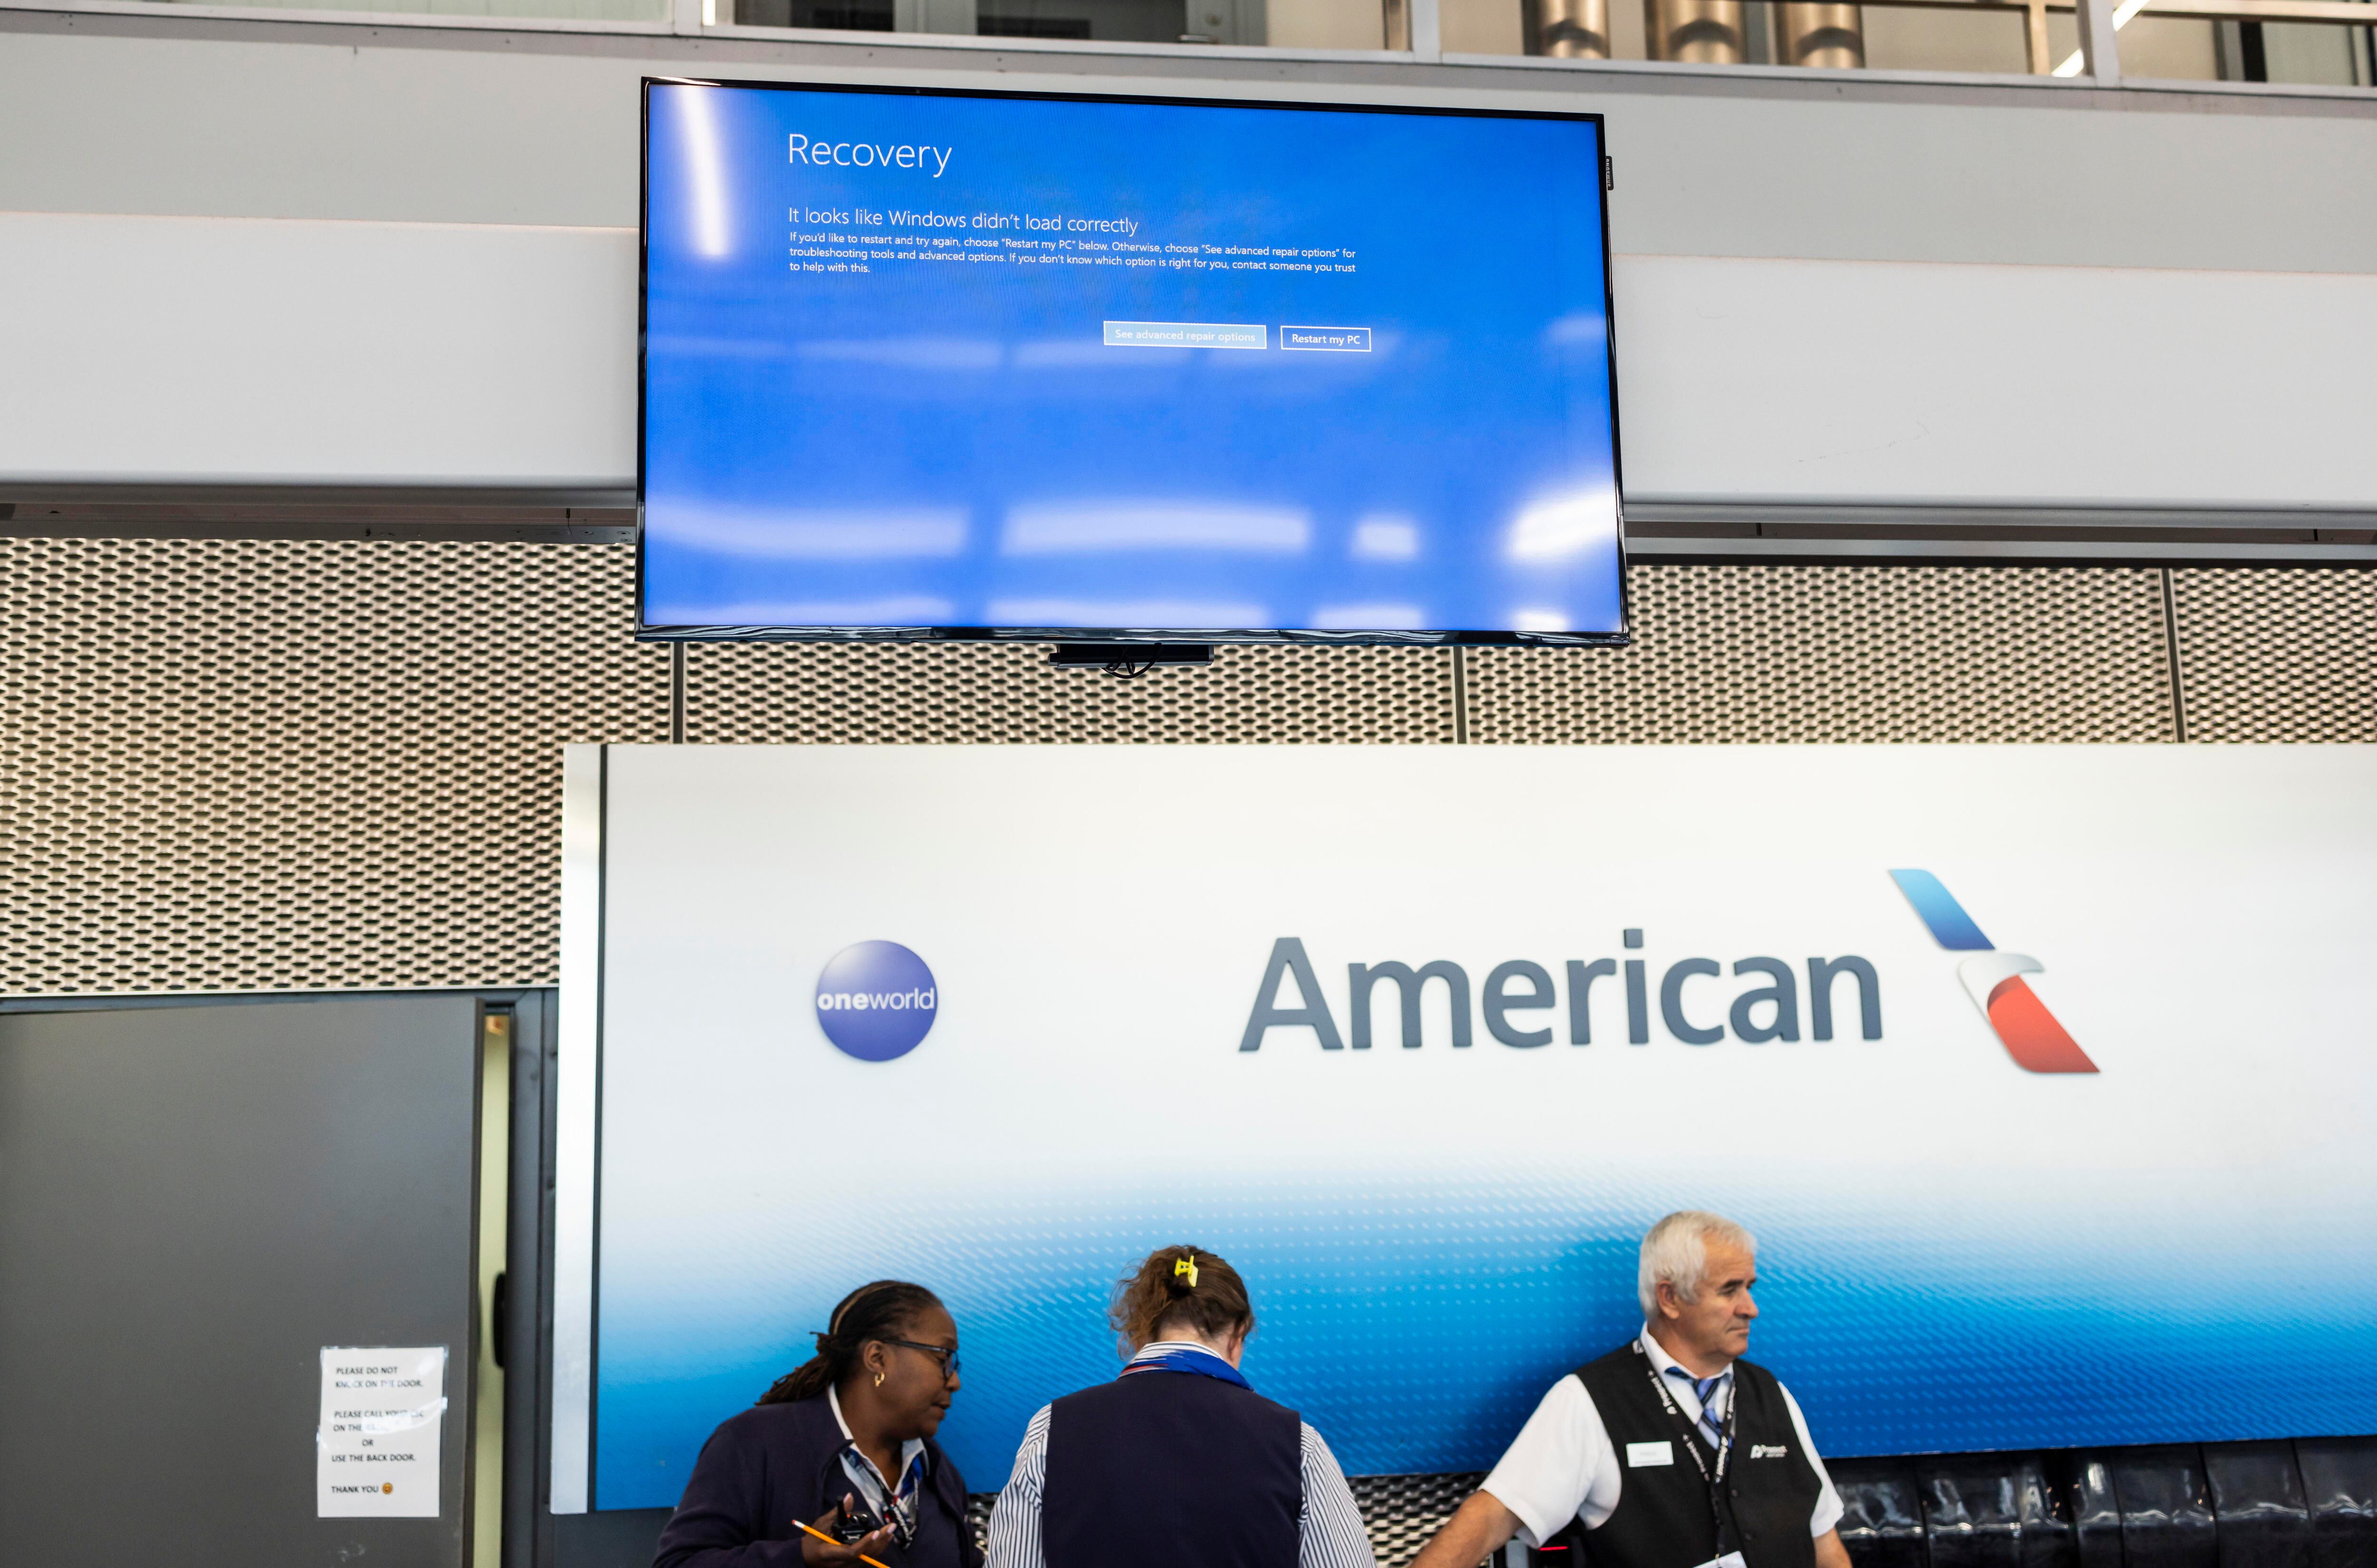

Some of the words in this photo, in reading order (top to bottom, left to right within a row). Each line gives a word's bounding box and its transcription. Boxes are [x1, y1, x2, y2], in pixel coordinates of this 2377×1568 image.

[789, 133, 952, 178] Recovery
[789, 207, 799, 223] It
[805, 207, 850, 225] looks
[855, 208, 883, 226] like
[888, 210, 966, 228] Windows
[1025, 213, 1062, 231] load
[1067, 217, 1139, 237] correctly
[790, 232, 797, 241] If
[828, 232, 845, 243] like
[847, 234, 858, 243] to
[860, 235, 892, 244] restart
[894, 235, 913, 245] and
[916, 236, 930, 248] try
[932, 236, 961, 248] again,
[964, 236, 999, 247] choose
[1041, 242, 1056, 252] my
[1078, 240, 1109, 251] below.
[1111, 242, 1162, 253] Otherwise,
[1164, 242, 1198, 253] choose
[1224, 245, 1270, 256] advanced
[1272, 247, 1299, 258] repair
[1342, 248, 1356, 258] for
[789, 246, 868, 261] troubleshooting
[870, 249, 895, 259] tools
[897, 250, 916, 260] and
[918, 250, 965, 261] advanced
[968, 252, 1006, 263] options.
[1009, 252, 1016, 262] If
[1018, 256, 1036, 265] you
[1066, 254, 1092, 264] know
[1094, 255, 1122, 265] which
[1124, 257, 1156, 268] option
[1159, 257, 1167, 267] is
[1169, 257, 1191, 270] right
[1193, 258, 1208, 268] for
[1209, 261, 1230, 271] you,
[1232, 261, 1267, 270] contact
[1269, 262, 1313, 271] someone
[1314, 264, 1332, 274] you
[1334, 263, 1356, 272] trust
[789, 262, 801, 271] to
[803, 261, 825, 274] help
[827, 262, 848, 272] with
[850, 262, 870, 273] this.
[1115, 329, 1133, 339] See
[1136, 329, 1184, 340] advanced
[1186, 331, 1216, 343] repair
[1218, 332, 1256, 343] options
[1292, 333, 1327, 344] Restart
[1329, 337, 1344, 347] my
[1347, 335, 1361, 345] PC
[1238, 927, 1884, 1054] American
[817, 987, 935, 1010] oneworld
[336, 1366, 364, 1374] PLEASE
[333, 1424, 345, 1432] ON
[362, 1439, 374, 1447] OR
[332, 1454, 346, 1462] USE
[349, 1454, 364, 1462] THE
[367, 1454, 387, 1462] BACK
[390, 1454, 416, 1462] DOOR.
[331, 1486, 359, 1494] THANK
[361, 1485, 378, 1493] YOU
